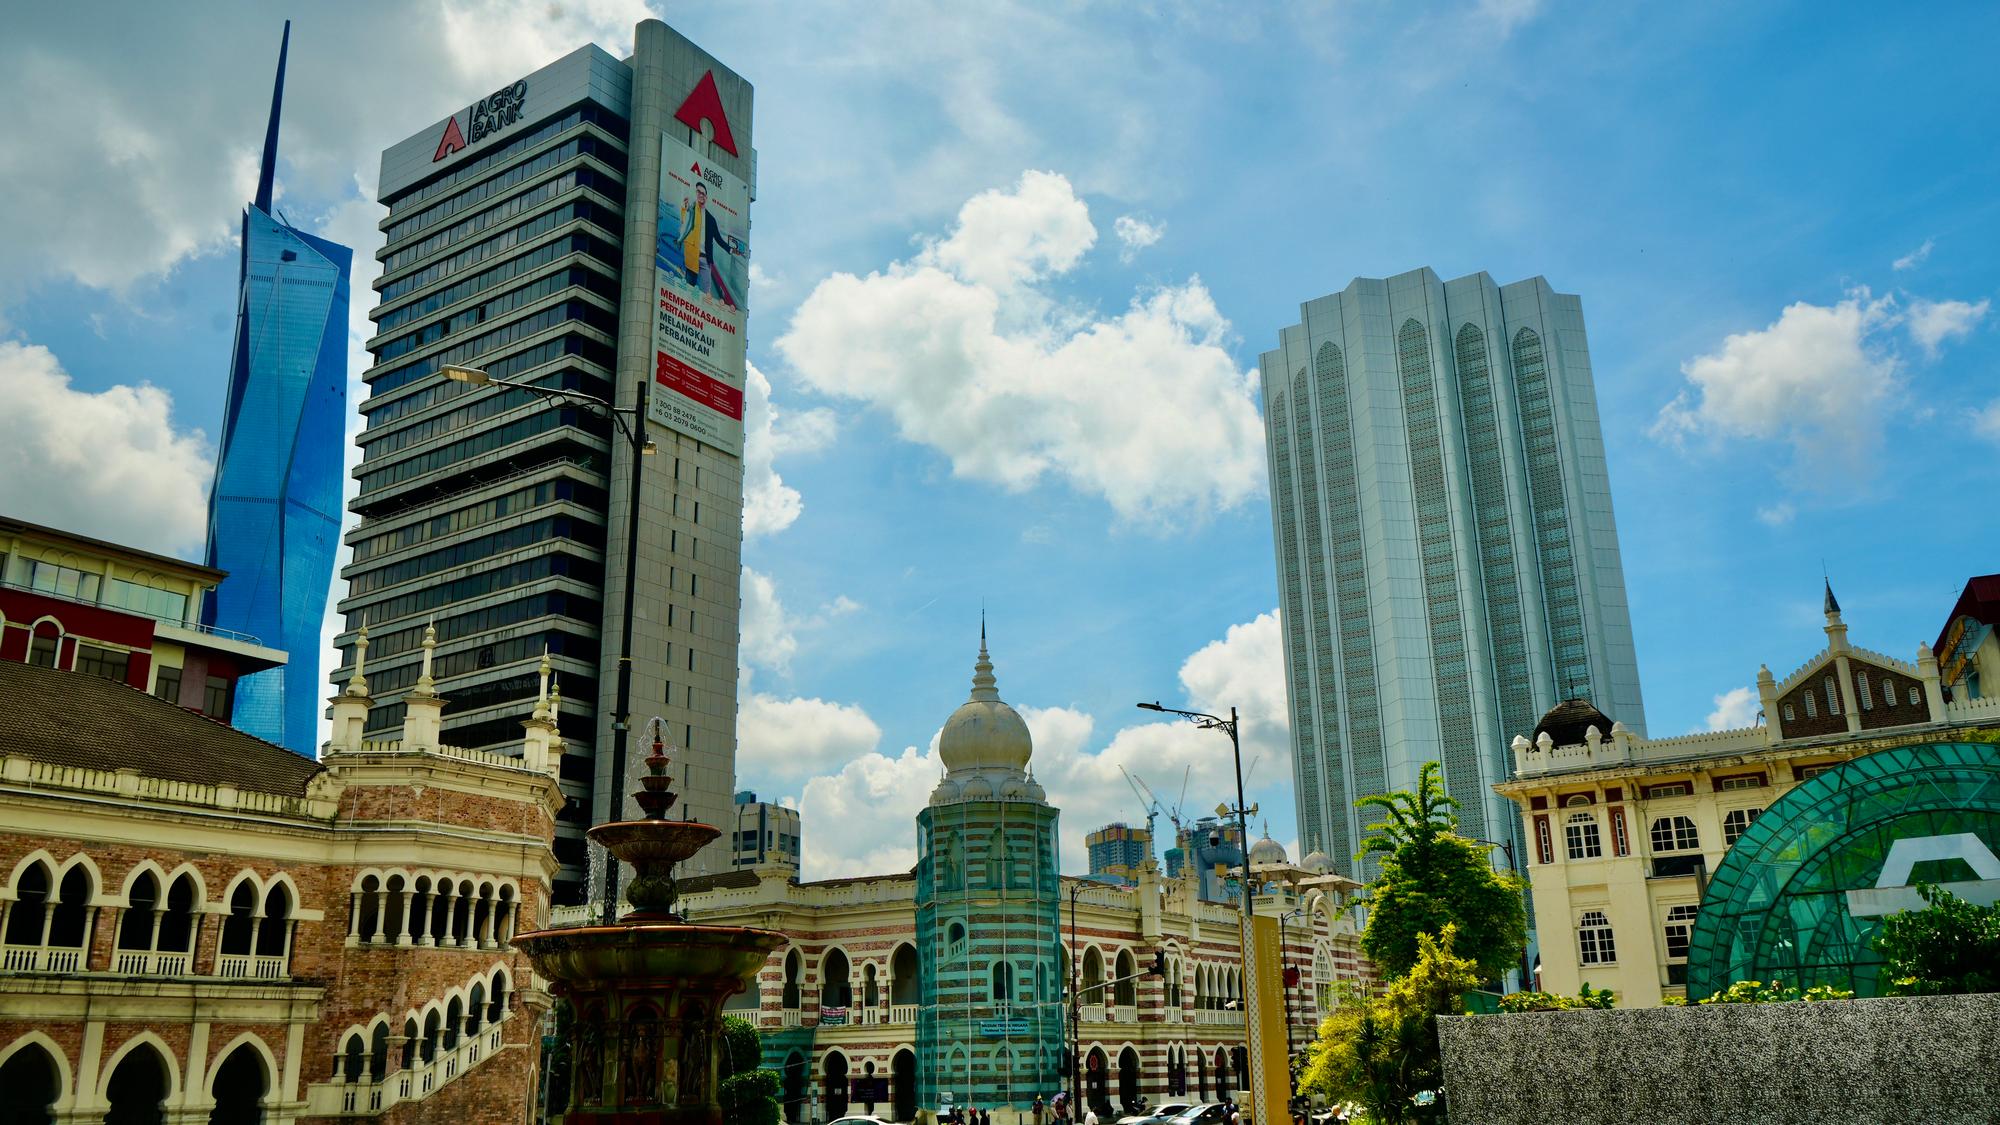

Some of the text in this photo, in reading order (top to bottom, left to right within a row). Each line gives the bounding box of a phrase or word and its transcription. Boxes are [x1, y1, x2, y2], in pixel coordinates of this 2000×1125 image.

[474, 79, 527, 122] AGRO
[472, 99, 525, 143] BANK
[703, 173, 722, 190] BANK
[704, 167, 723, 183] AGRO
[660, 287, 736, 335] MEMPERKASAKAN
[660, 299, 704, 331] PERTANIAN
[659, 311, 715, 348] MELANGKAUI
[659, 322, 710, 357] PERBANKAN
[660, 399, 672, 411] 300
[672, 406, 681, 415] 88
[682, 411, 697, 423] 2476
[664, 411, 673, 420] 03
[673, 415, 689, 428] 2079
